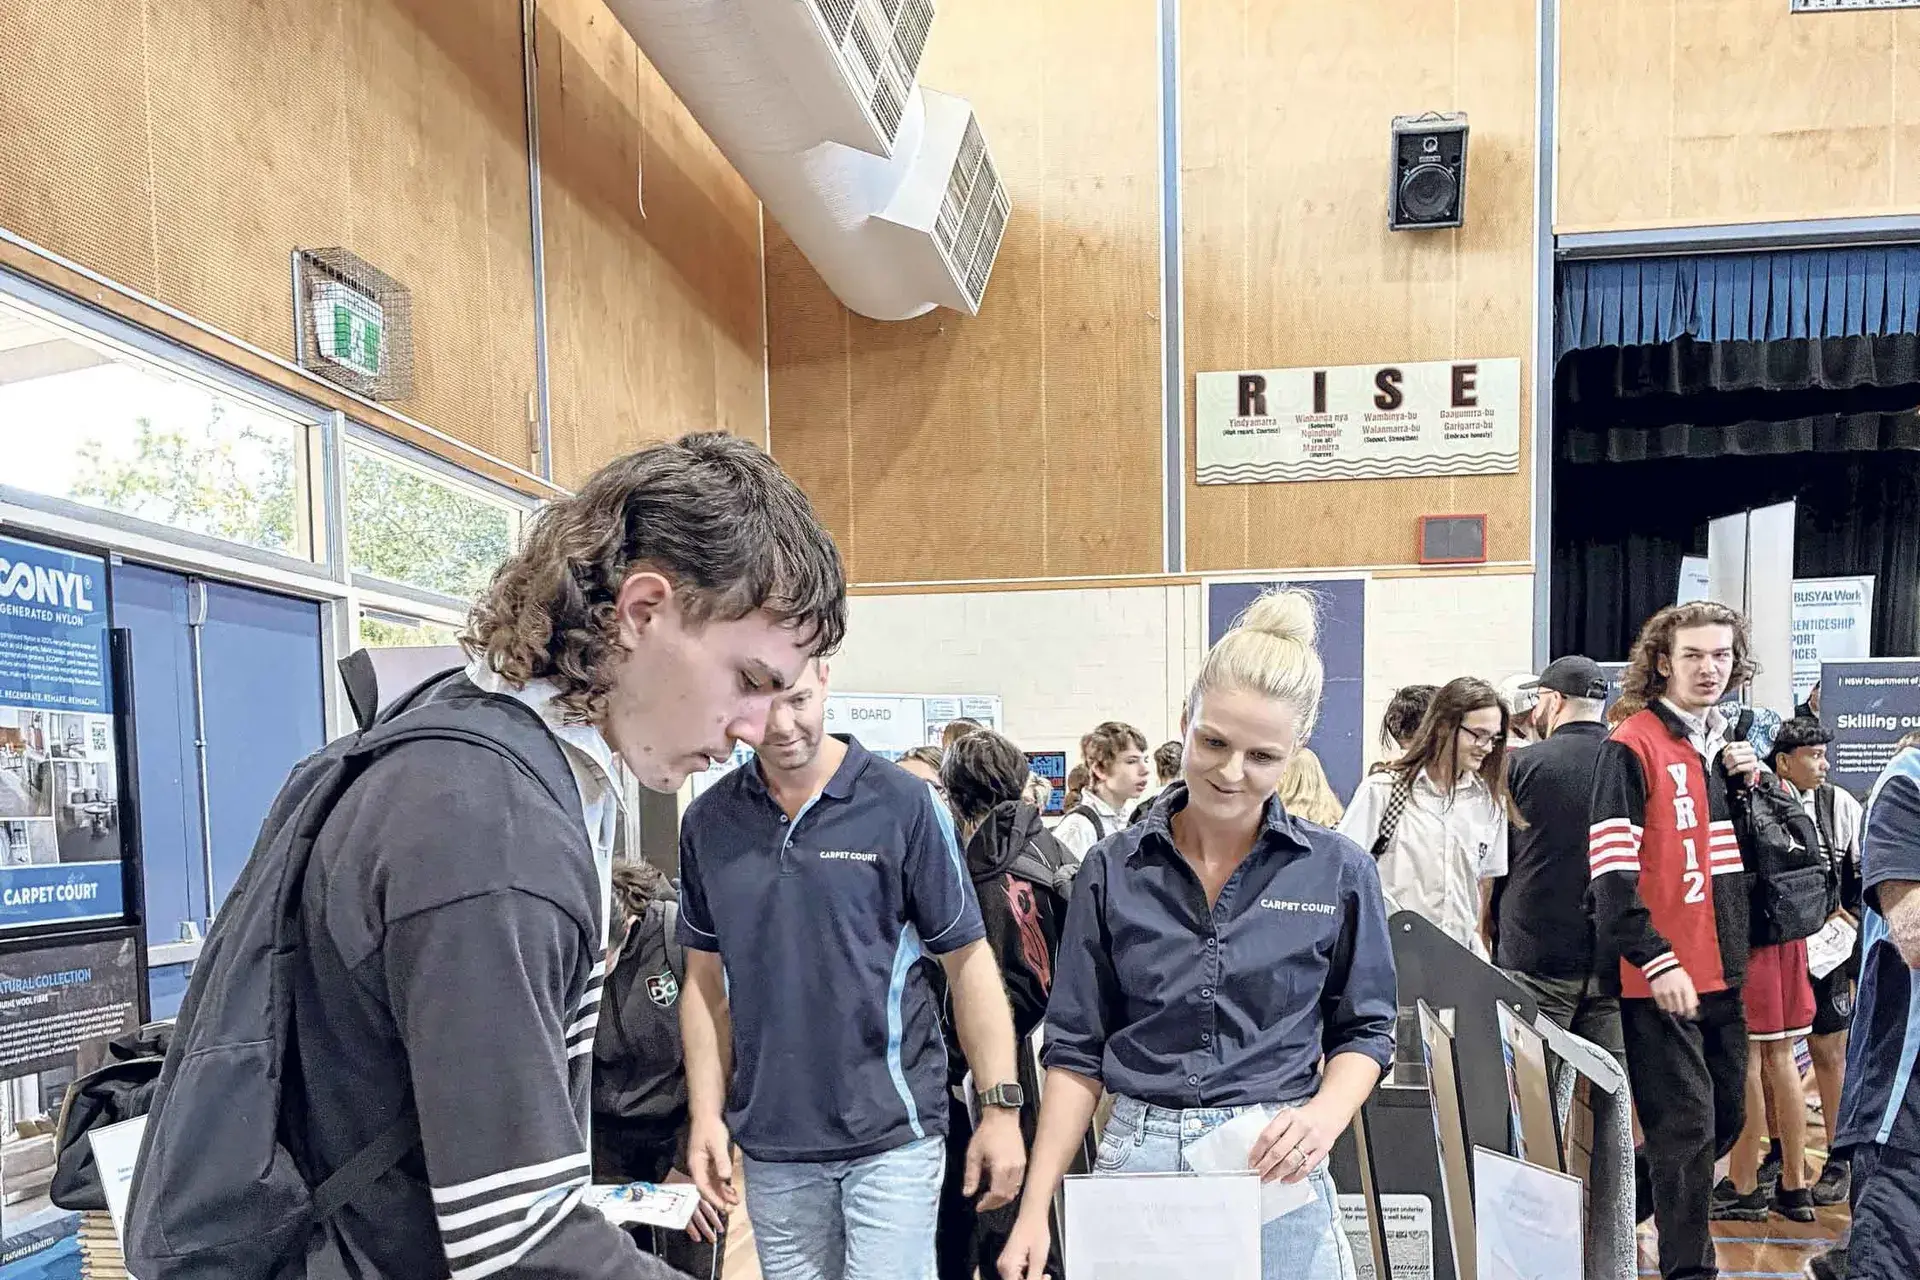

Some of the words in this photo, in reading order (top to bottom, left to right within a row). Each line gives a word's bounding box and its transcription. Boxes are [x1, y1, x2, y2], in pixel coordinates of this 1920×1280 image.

[55, 612, 83, 627] NYLON
[1864, 677, 1909, 687] Department
[851, 708, 891, 721] BOARD
[1837, 713, 1897, 731] Skilling
[819, 851, 850, 859] CARPET
[850, 852, 877, 863] COURT
[3, 885, 54, 905] CARPET
[56, 882, 98, 901] COURT
[1260, 899, 1300, 912] CARPET
[1301, 903, 1336, 915] COURT
[35, 968, 92, 988] COLLECTION
